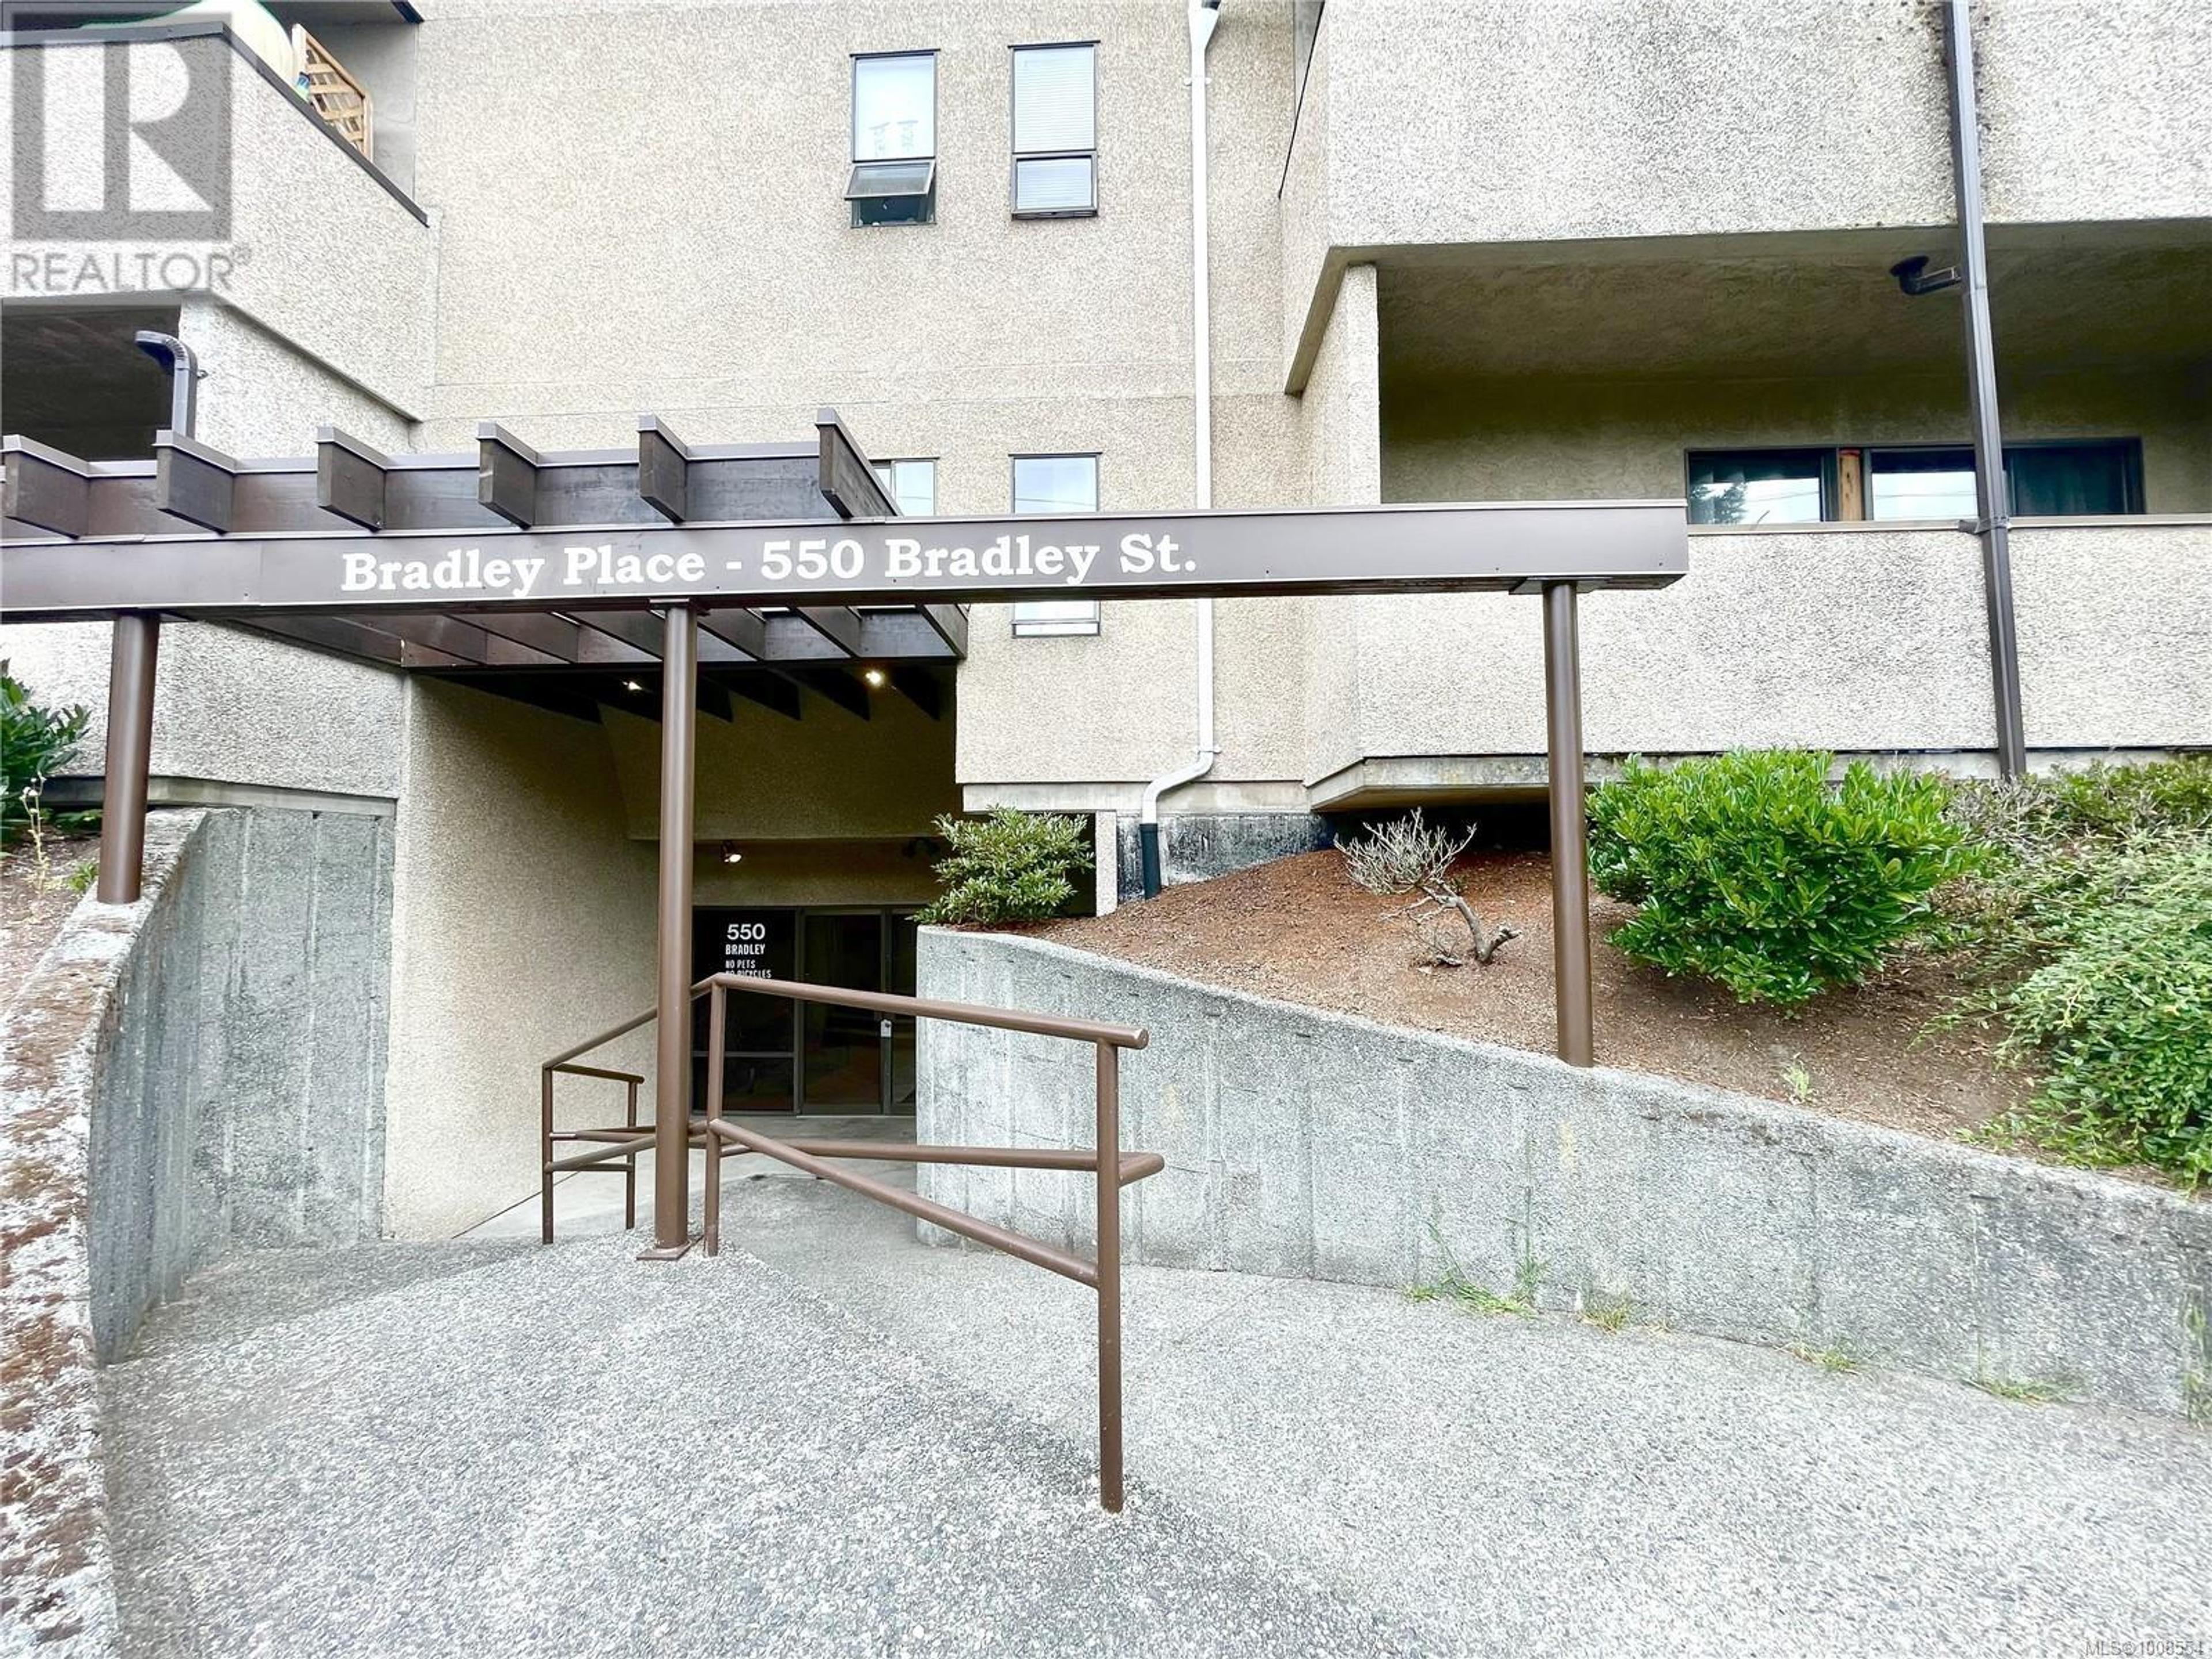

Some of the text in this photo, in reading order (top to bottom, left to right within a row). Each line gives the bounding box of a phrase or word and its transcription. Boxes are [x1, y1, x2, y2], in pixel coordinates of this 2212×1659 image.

[340, 548, 546, 596] Bradley
[563, 544, 706, 586] Place
[760, 539, 865, 581] 550
[884, 535, 1101, 585] Bradley
[1119, 533, 1197, 574] St.
[726, 923, 766, 940] 550
[725, 943, 766, 955] BRADLEY
[725, 959, 756, 969] NO PETS
